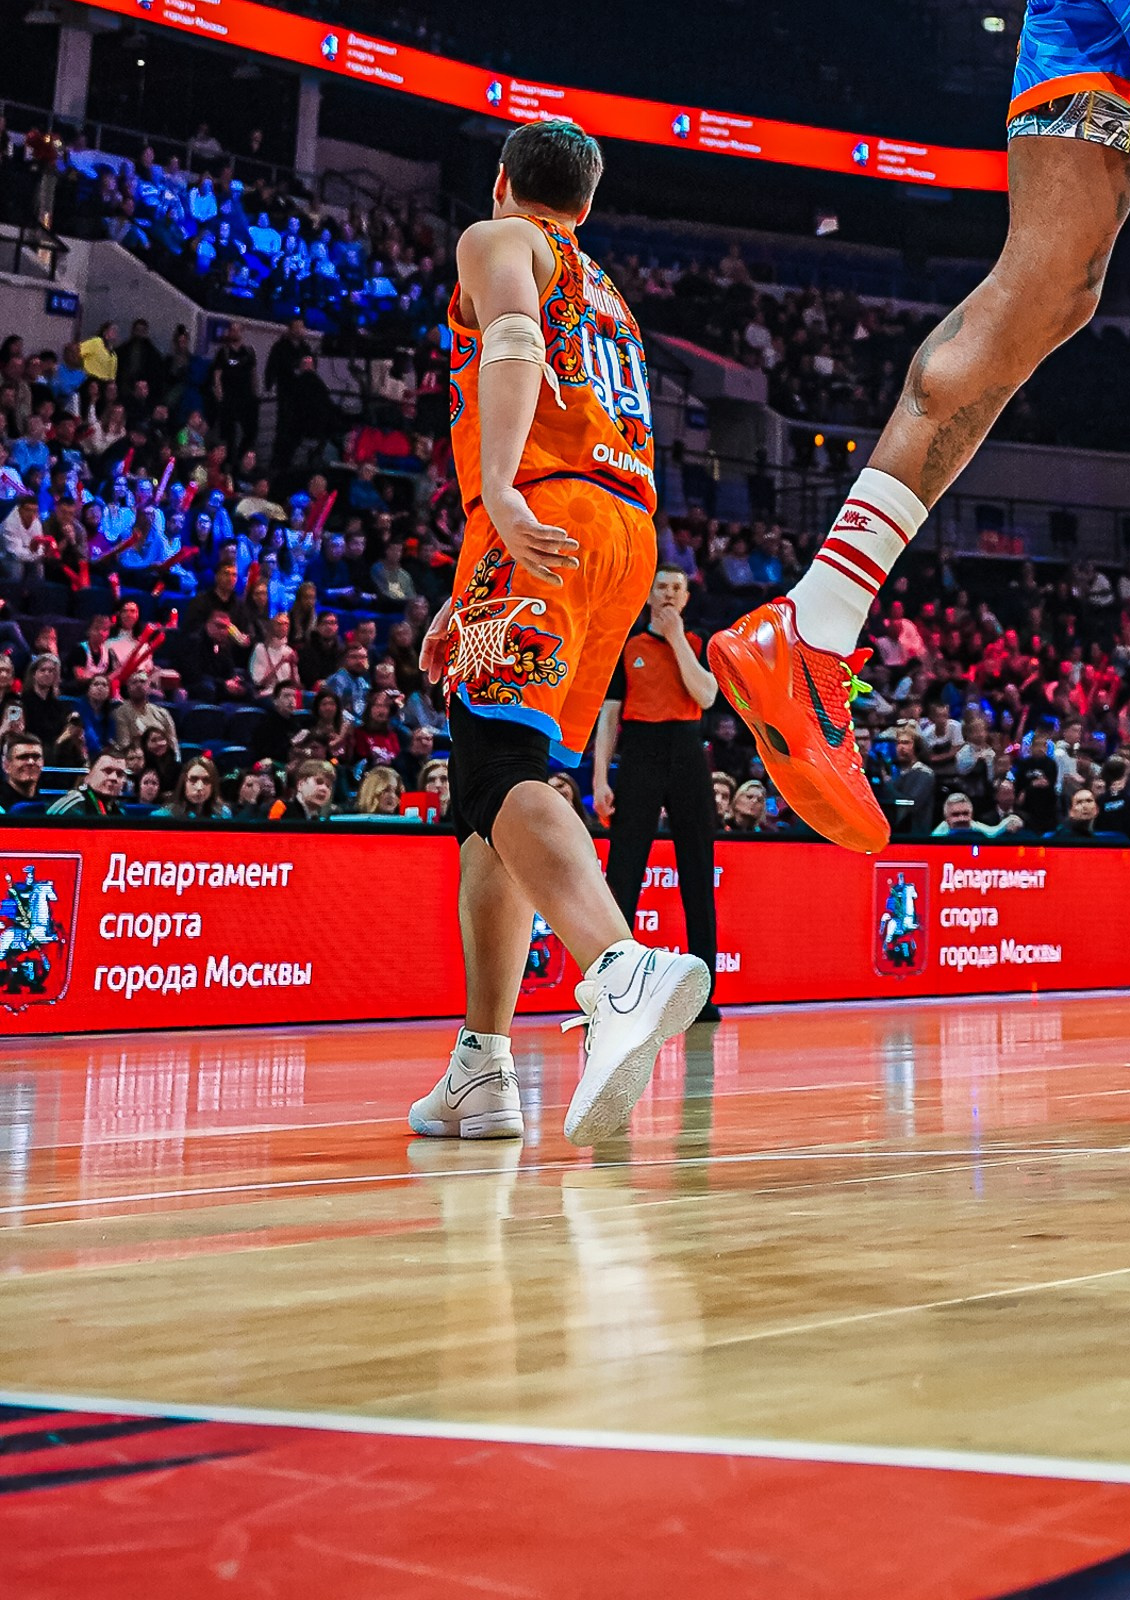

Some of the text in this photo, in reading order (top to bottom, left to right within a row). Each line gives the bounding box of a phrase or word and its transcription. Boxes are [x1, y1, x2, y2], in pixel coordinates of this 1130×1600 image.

[841, 510, 872, 527] NIKE
[102, 854, 293, 893] Департамент
[940, 863, 1047, 895] Департамент
[100, 912, 201, 946] спорта
[940, 907, 999, 933] спорта
[940, 939, 1062, 973] города Москвы
[95, 956, 312, 1000] города Москвы
